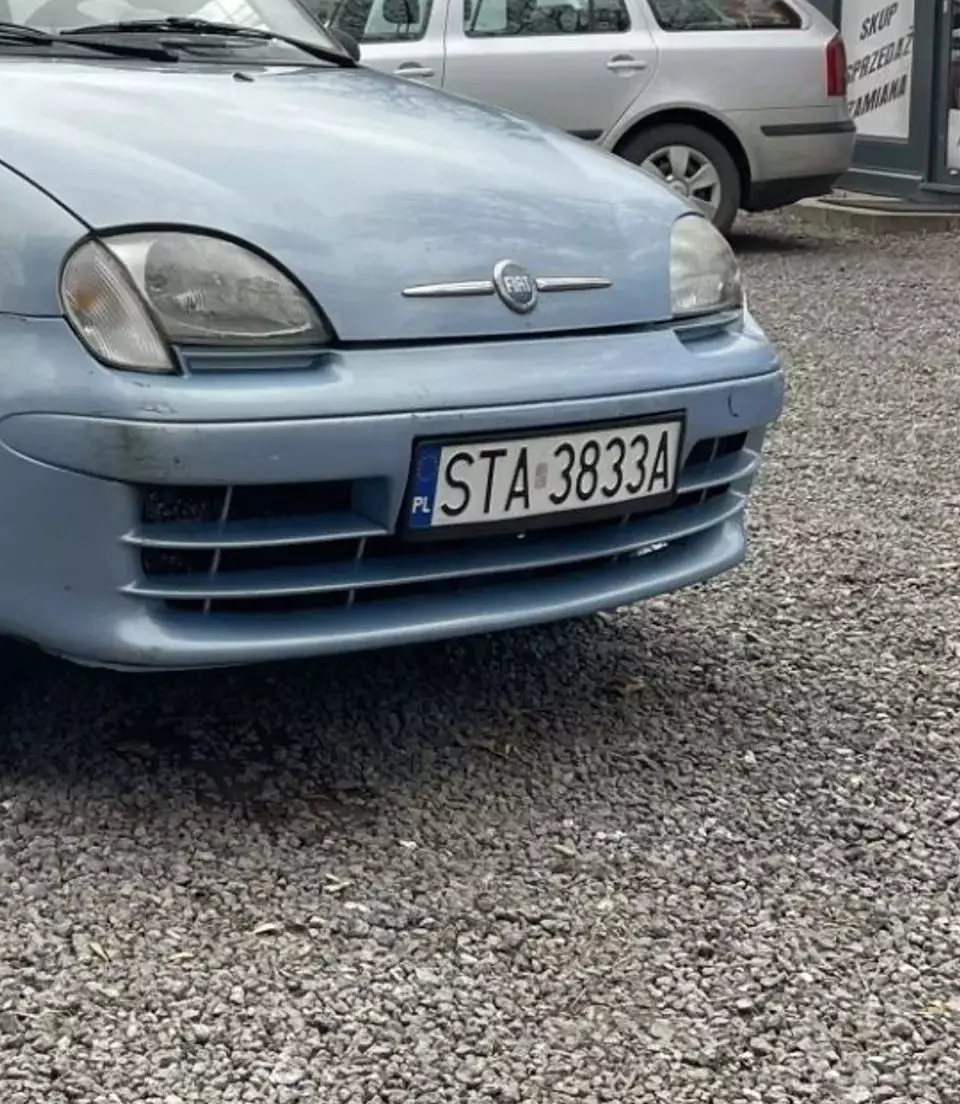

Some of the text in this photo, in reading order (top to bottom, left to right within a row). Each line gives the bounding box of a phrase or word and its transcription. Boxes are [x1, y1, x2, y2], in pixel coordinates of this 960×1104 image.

[860, 1, 898, 41] SKUP
[503, 275, 531, 293] FIAT
[441, 430, 669, 516] STA 3833A
[412, 495, 431, 514] PL
